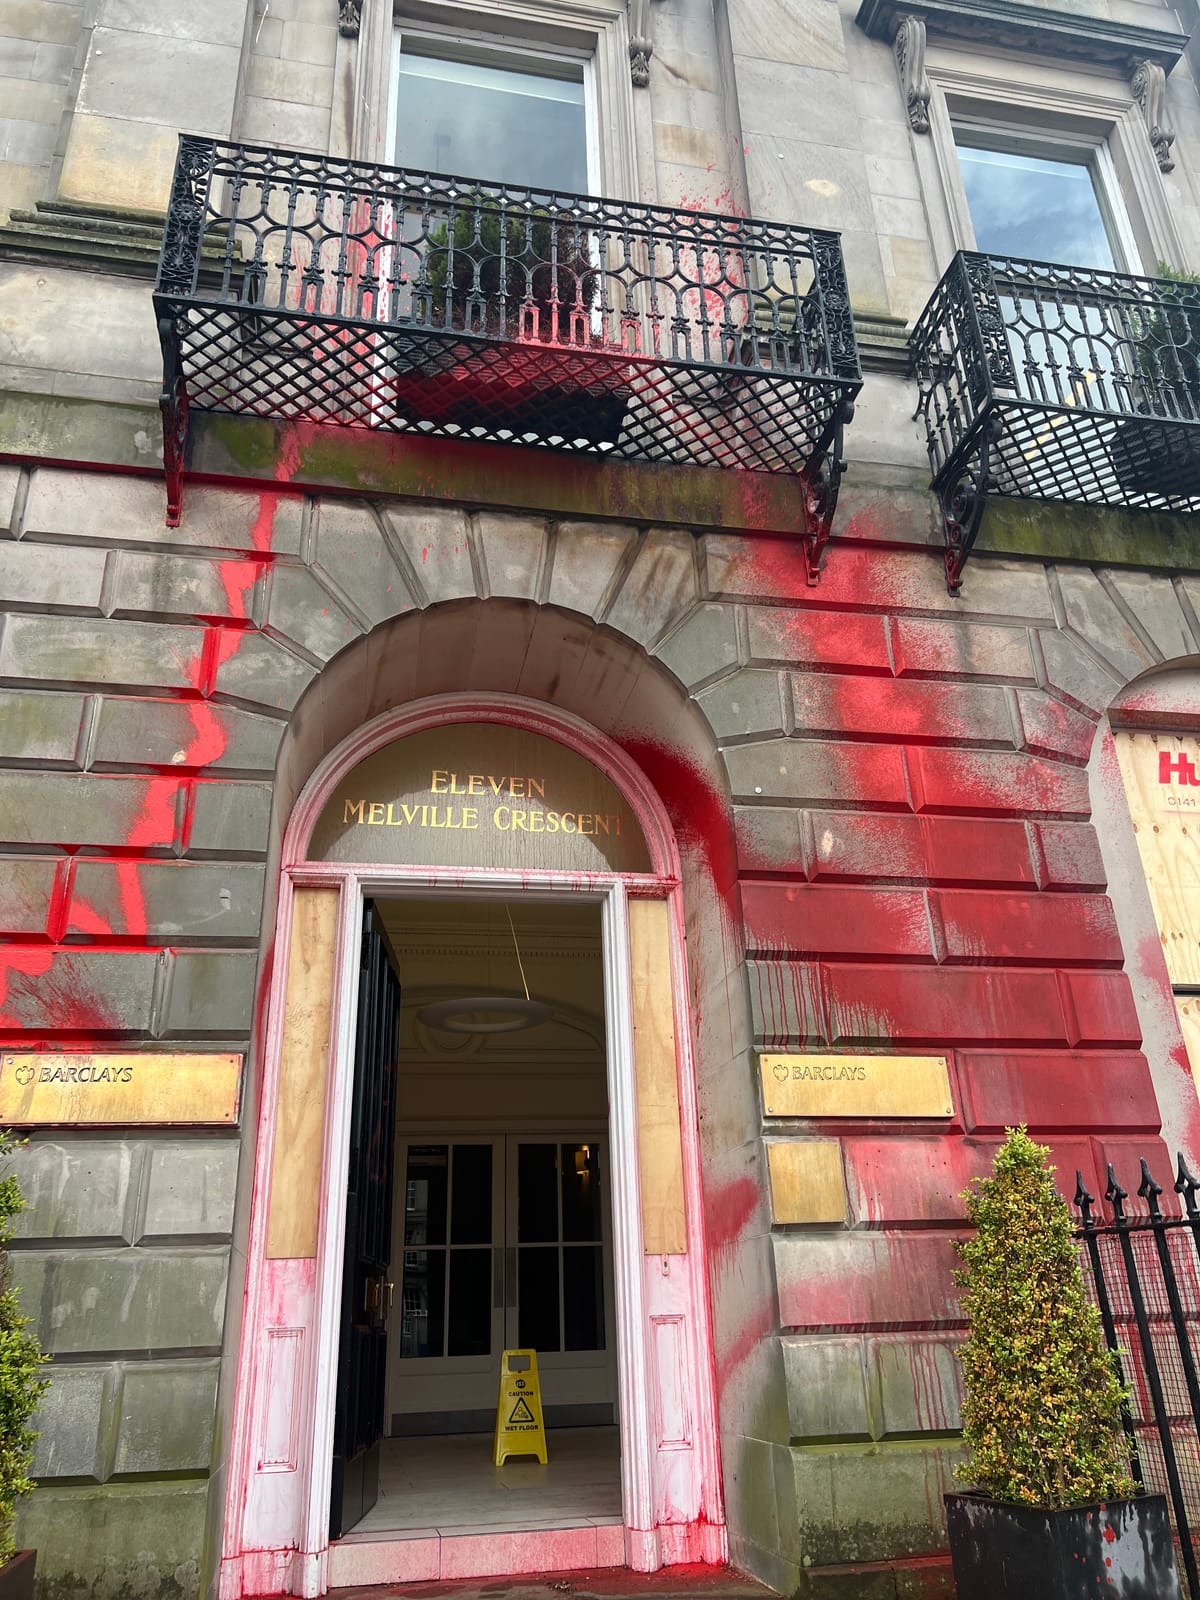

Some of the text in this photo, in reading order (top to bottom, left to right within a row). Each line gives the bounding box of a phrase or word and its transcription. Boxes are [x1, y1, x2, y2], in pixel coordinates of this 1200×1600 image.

[430, 770, 545, 798] ELEVEN
[342, 799, 624, 836] MELVILLE CRESCENT
[37, 1067, 133, 1083] BARCLAYS
[792, 1066, 866, 1081] BARCLAYS
